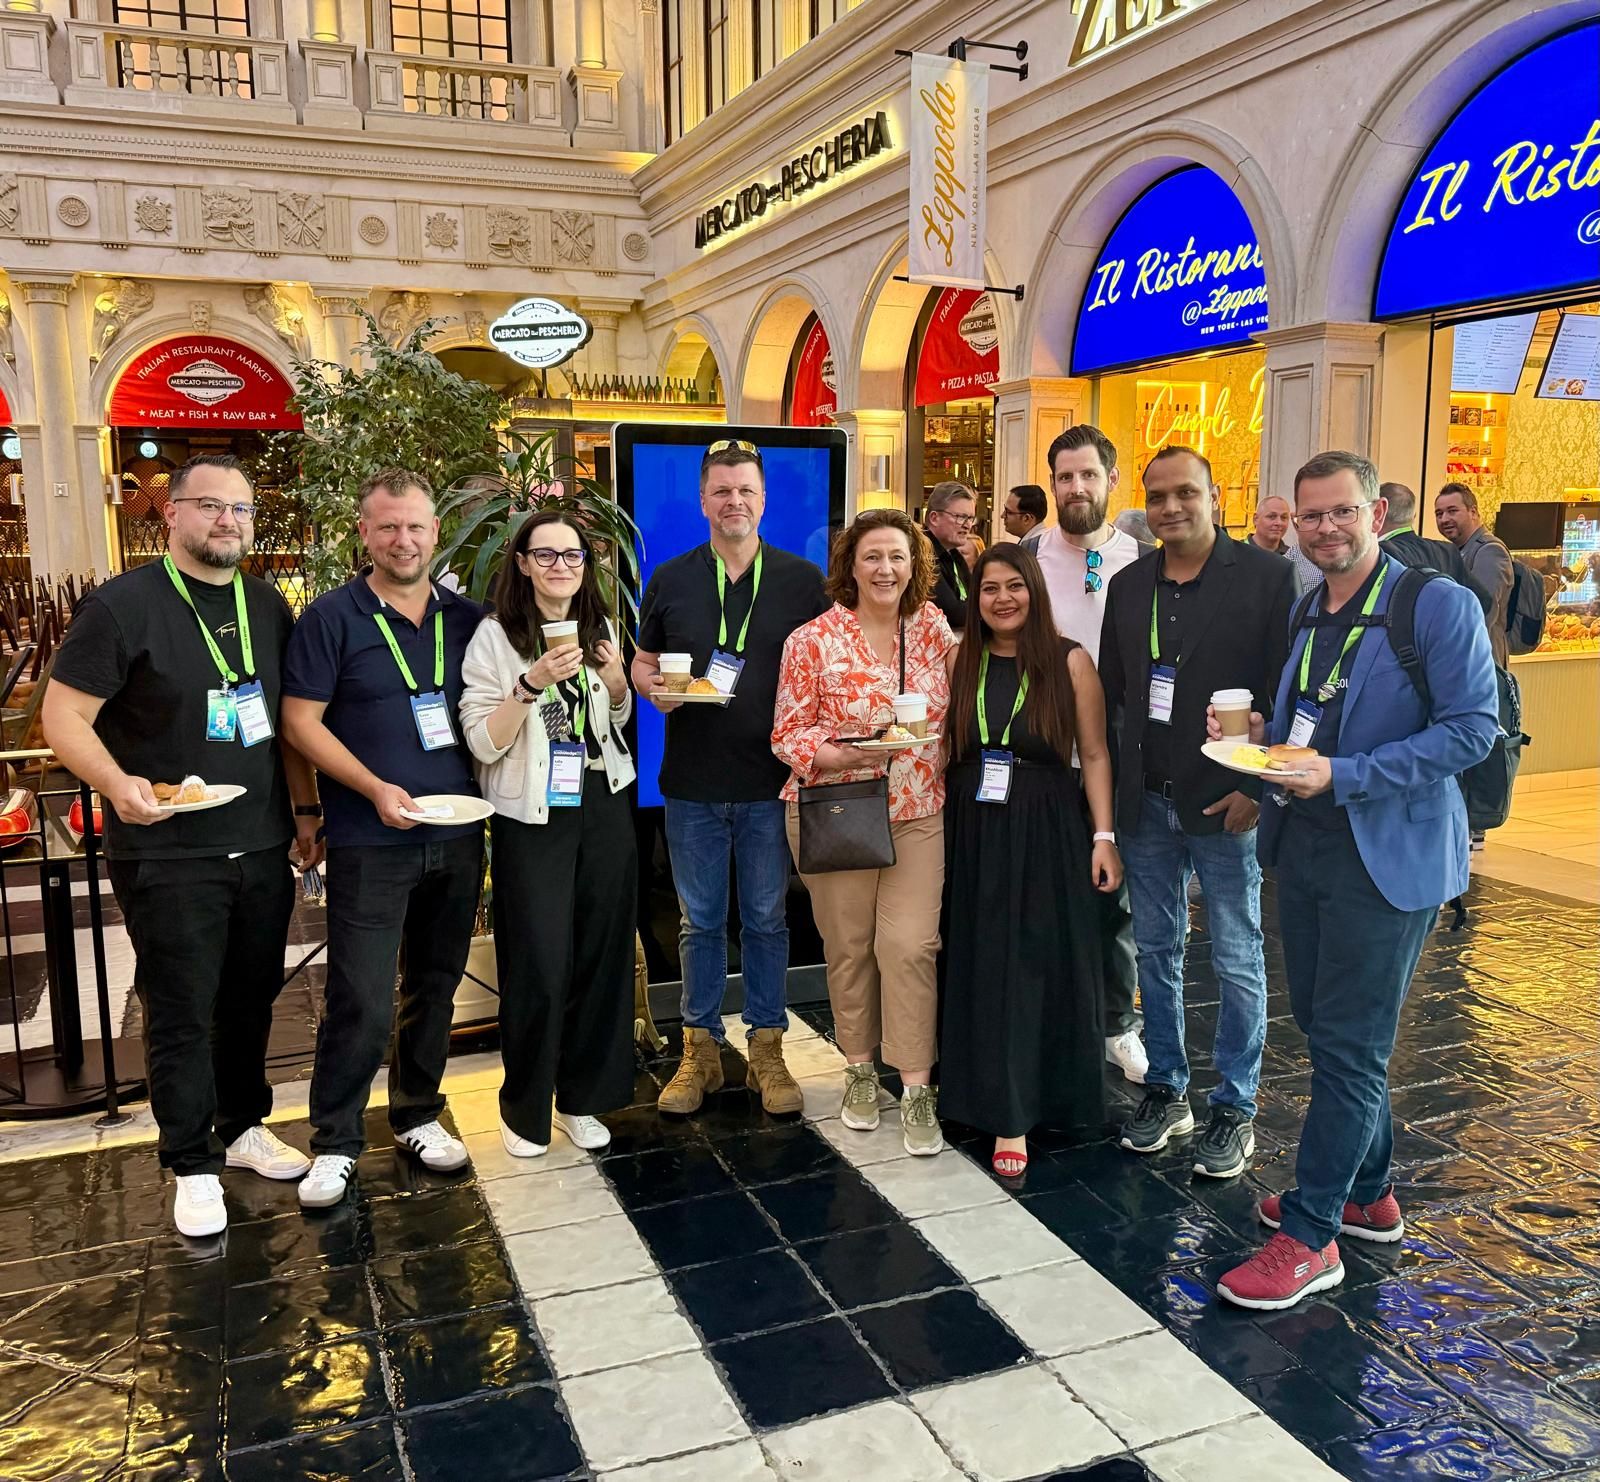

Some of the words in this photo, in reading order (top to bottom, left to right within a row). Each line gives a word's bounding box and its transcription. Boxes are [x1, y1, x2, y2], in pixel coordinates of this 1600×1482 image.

[1068, 0, 1187, 67] ZE
[695, 183, 767, 248] MERCATO
[782, 111, 893, 201] PESCHERIA
[1403, 160, 1470, 234] Il
[1483, 119, 1600, 213] Risto
[1088, 259, 1125, 311] Il
[494, 327, 531, 339] MERCATO
[538, 325, 580, 337] PESCHERIA
[1240, 318, 1253, 327] LAS
[1256, 315, 1268, 324] VEG
[137, 352, 170, 380] ITALIAN
[172, 346, 236, 358] RESTAURANT
[236, 354, 274, 384] MARKET
[170, 378, 201, 386] MERCATO
[208, 379, 242, 387] PESCHERIA
[947, 376, 966, 390] PIZZA
[974, 371, 995, 385] PASTA
[149, 409, 175, 418] MEAT
[189, 410, 209, 419] FISH
[223, 411, 246, 420] RAW
[248, 411, 267, 420] BAR
